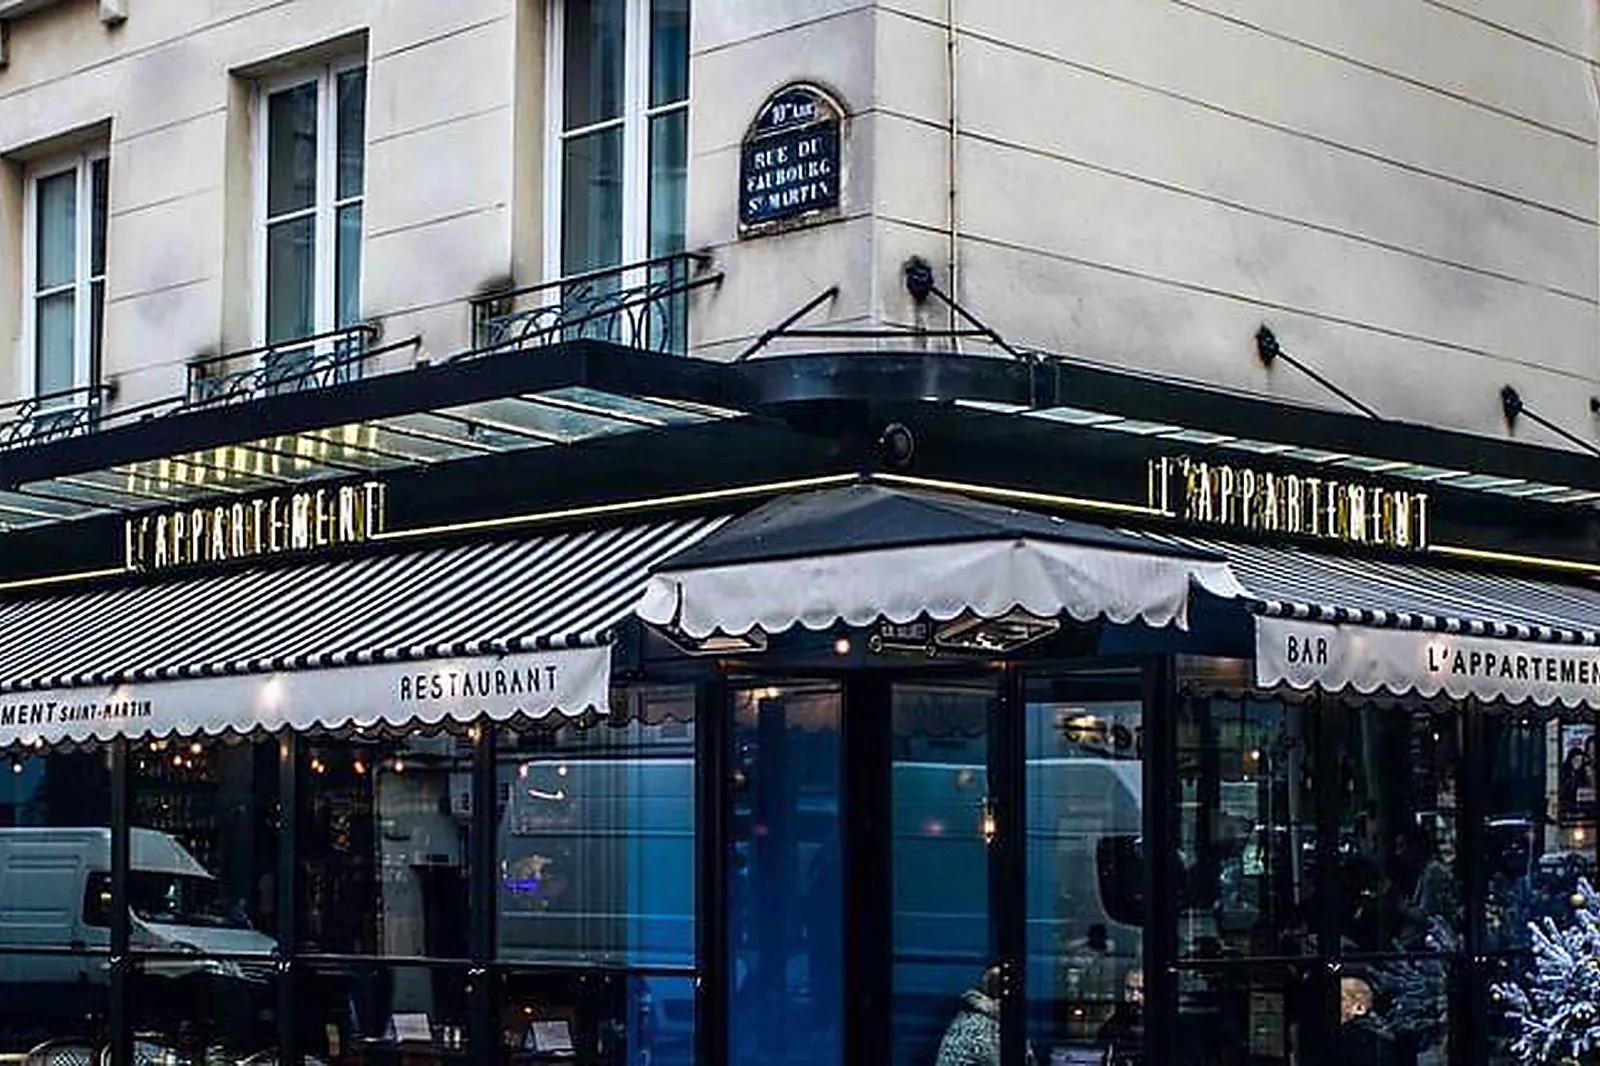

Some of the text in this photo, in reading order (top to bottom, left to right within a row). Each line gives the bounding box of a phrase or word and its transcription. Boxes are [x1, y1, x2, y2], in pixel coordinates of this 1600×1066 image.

[754, 137, 822, 169] RUE DU
[746, 159, 831, 192] FAUBOURG
[1160, 454, 1430, 549] L'APPARTEMENT
[125, 481, 380, 570] L'APPARTEMENT
[1286, 635, 1328, 665] BAR
[400, 665, 557, 700] RESTAURANT
[1, 700, 152, 726] MENT SAINT-MARTIN
